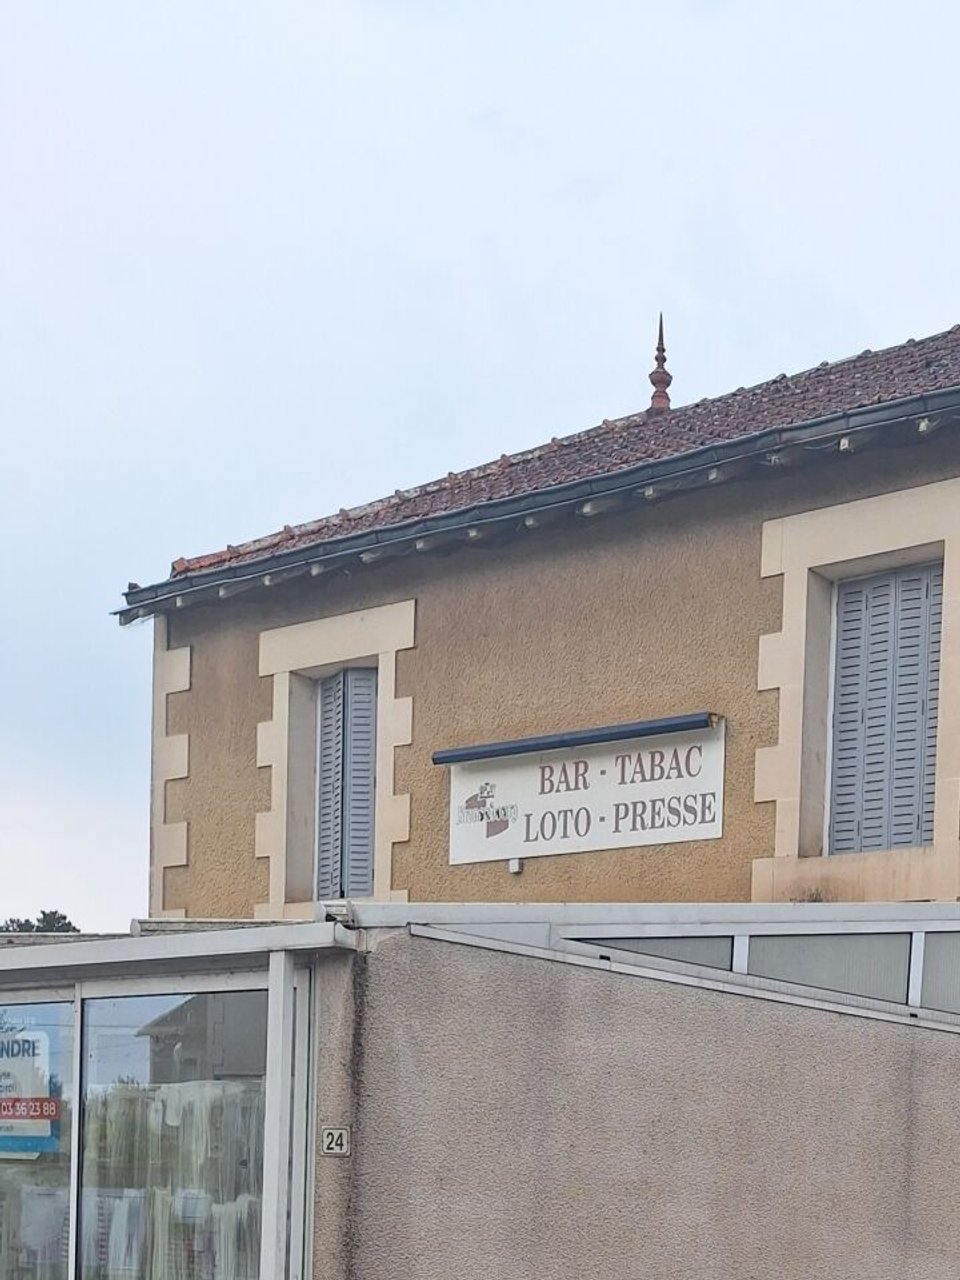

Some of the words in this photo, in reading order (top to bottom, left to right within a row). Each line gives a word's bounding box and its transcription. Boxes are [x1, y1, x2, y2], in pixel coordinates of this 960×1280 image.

[538, 760, 591, 795] BAR
[614, 745, 703, 785] TABAC
[523, 806, 592, 842] LOTO
[612, 792, 716, 834] PRESSE
[1, 1102, 13, 1116] 03
[14, 1102, 27, 1116] 36
[29, 1102, 41, 1116] 23
[42, 1102, 56, 1116] 88
[326, 1132, 344, 1151] 24
